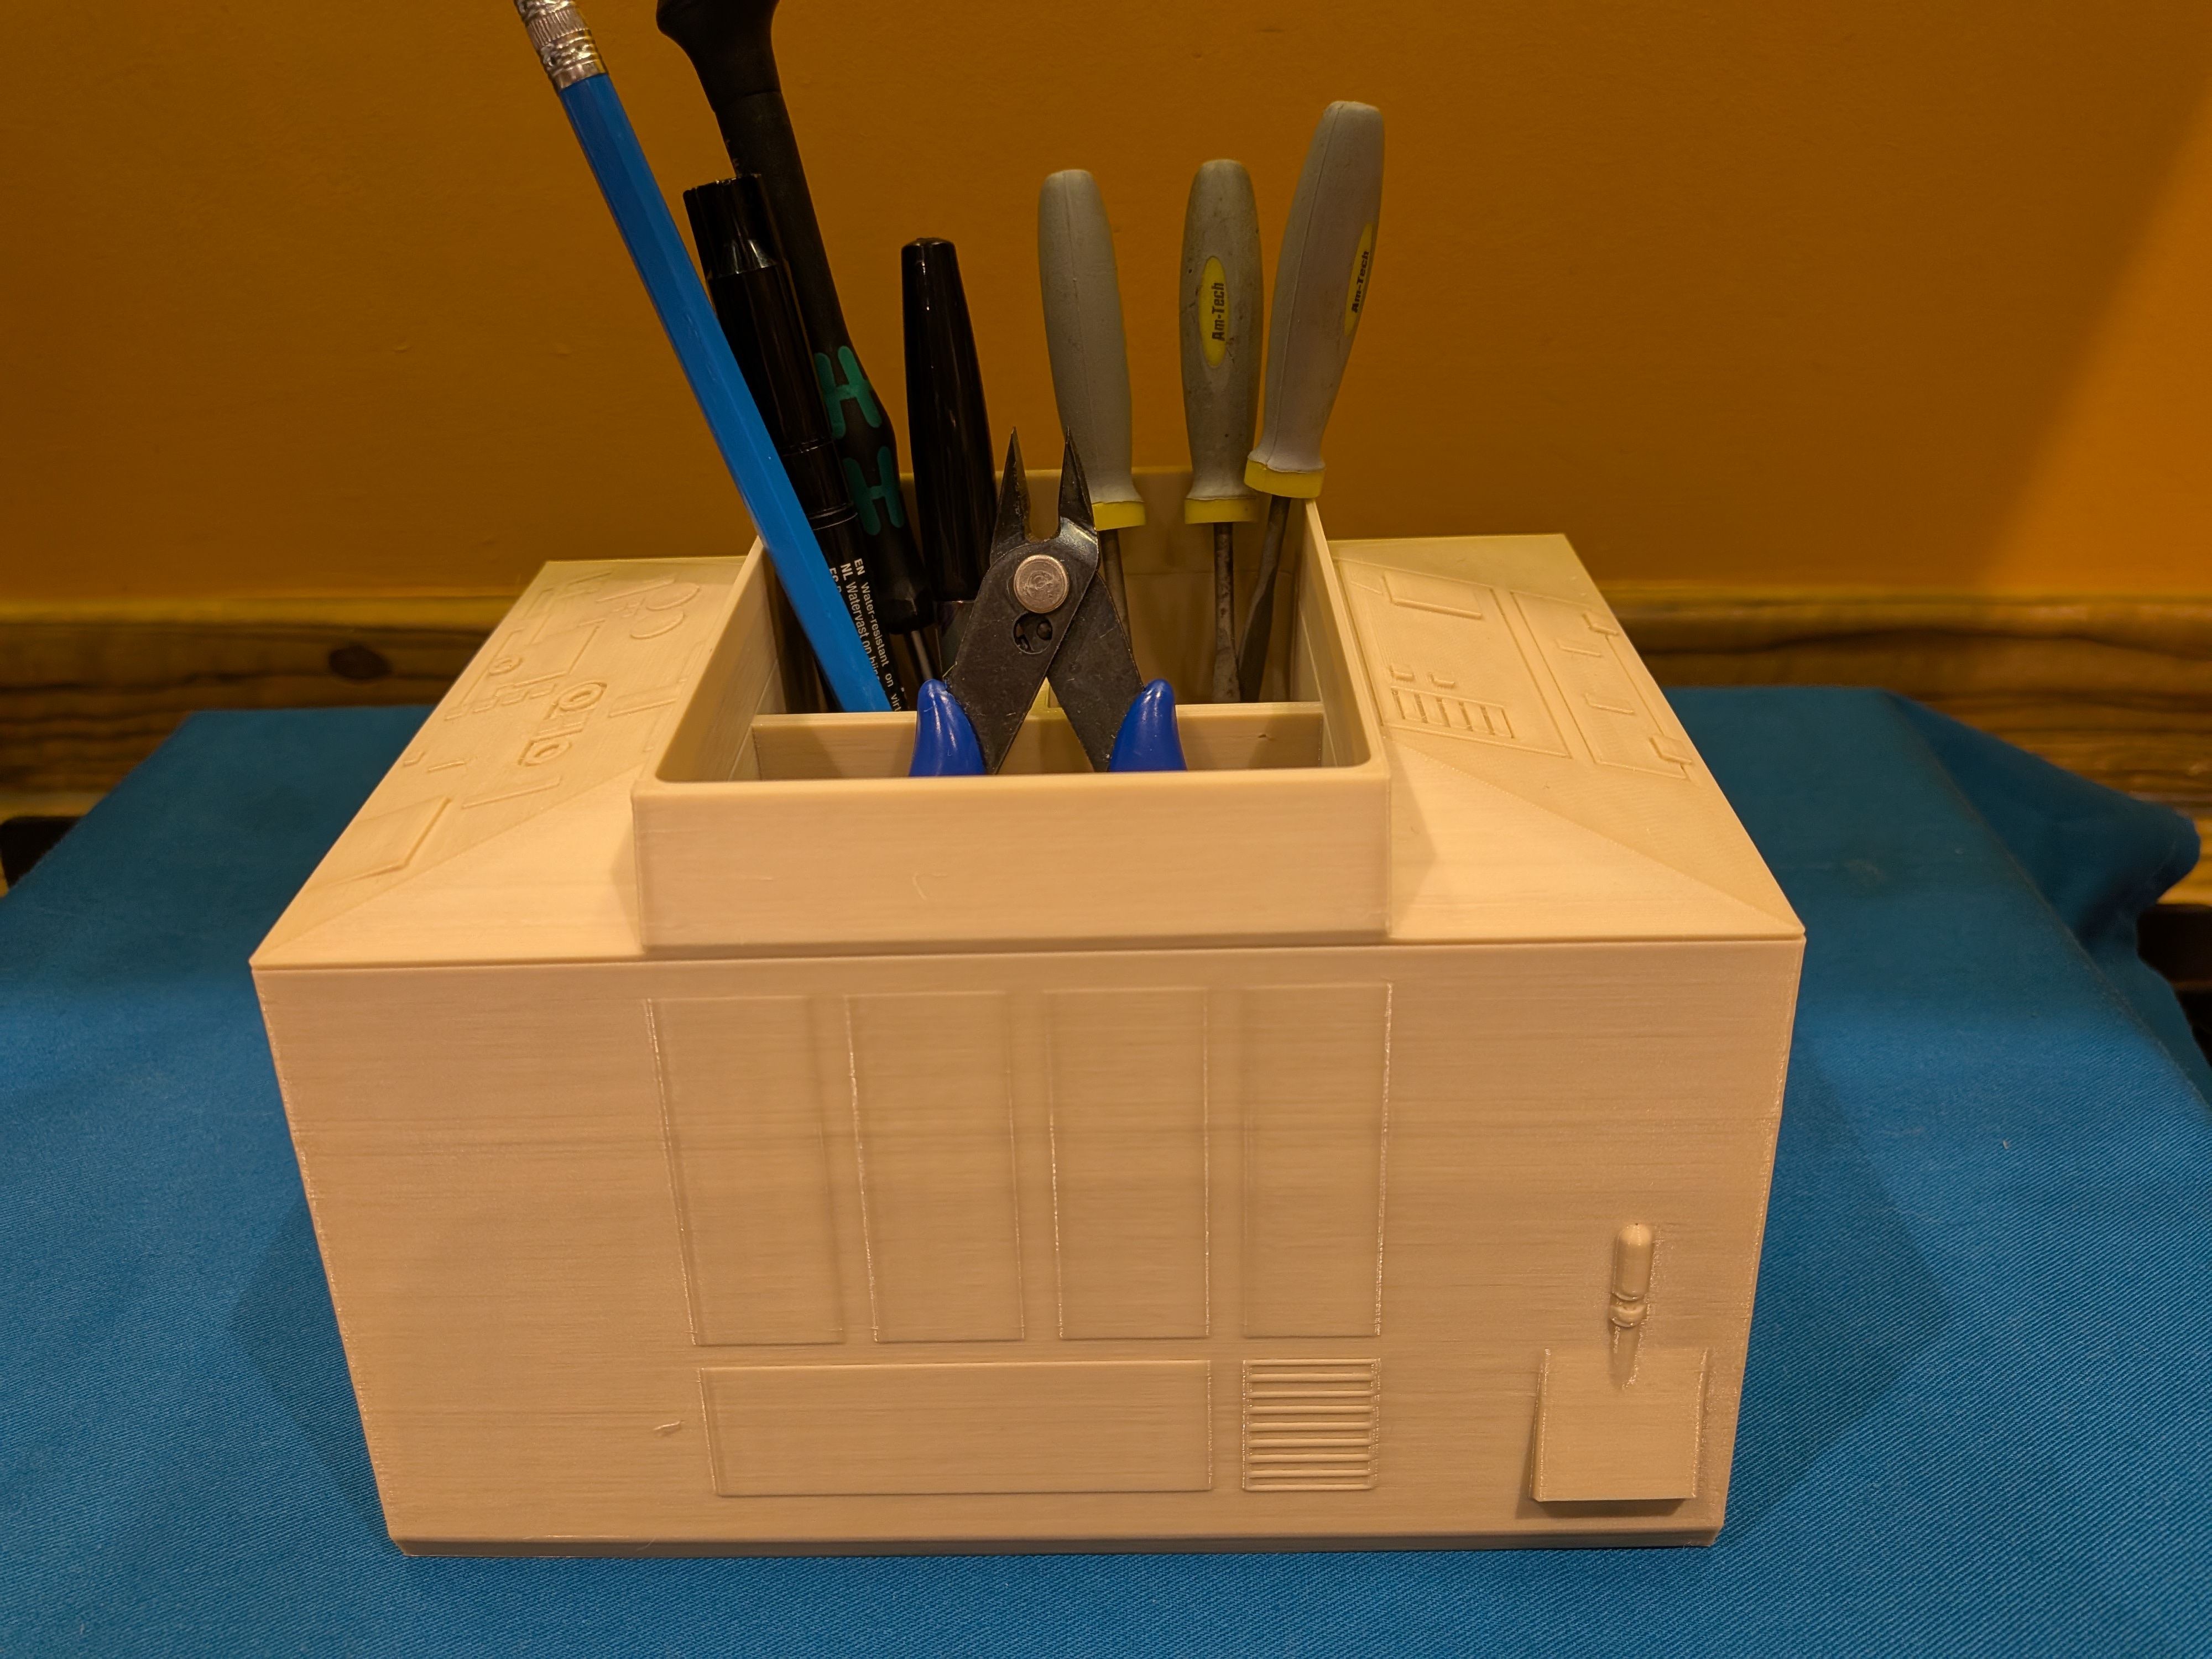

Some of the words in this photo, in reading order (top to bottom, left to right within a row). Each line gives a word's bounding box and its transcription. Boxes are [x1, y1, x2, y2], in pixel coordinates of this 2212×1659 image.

[1350, 251, 1370, 314] Am-Tech
[840, 562, 853, 581] NL
[846, 581, 870, 639] Watervast
[854, 558, 865, 576] EN
[860, 582, 890, 667] Water-resistant
[885, 672, 894, 687] on
[890, 693, 902, 712] virt
[862, 640, 872, 654] on
